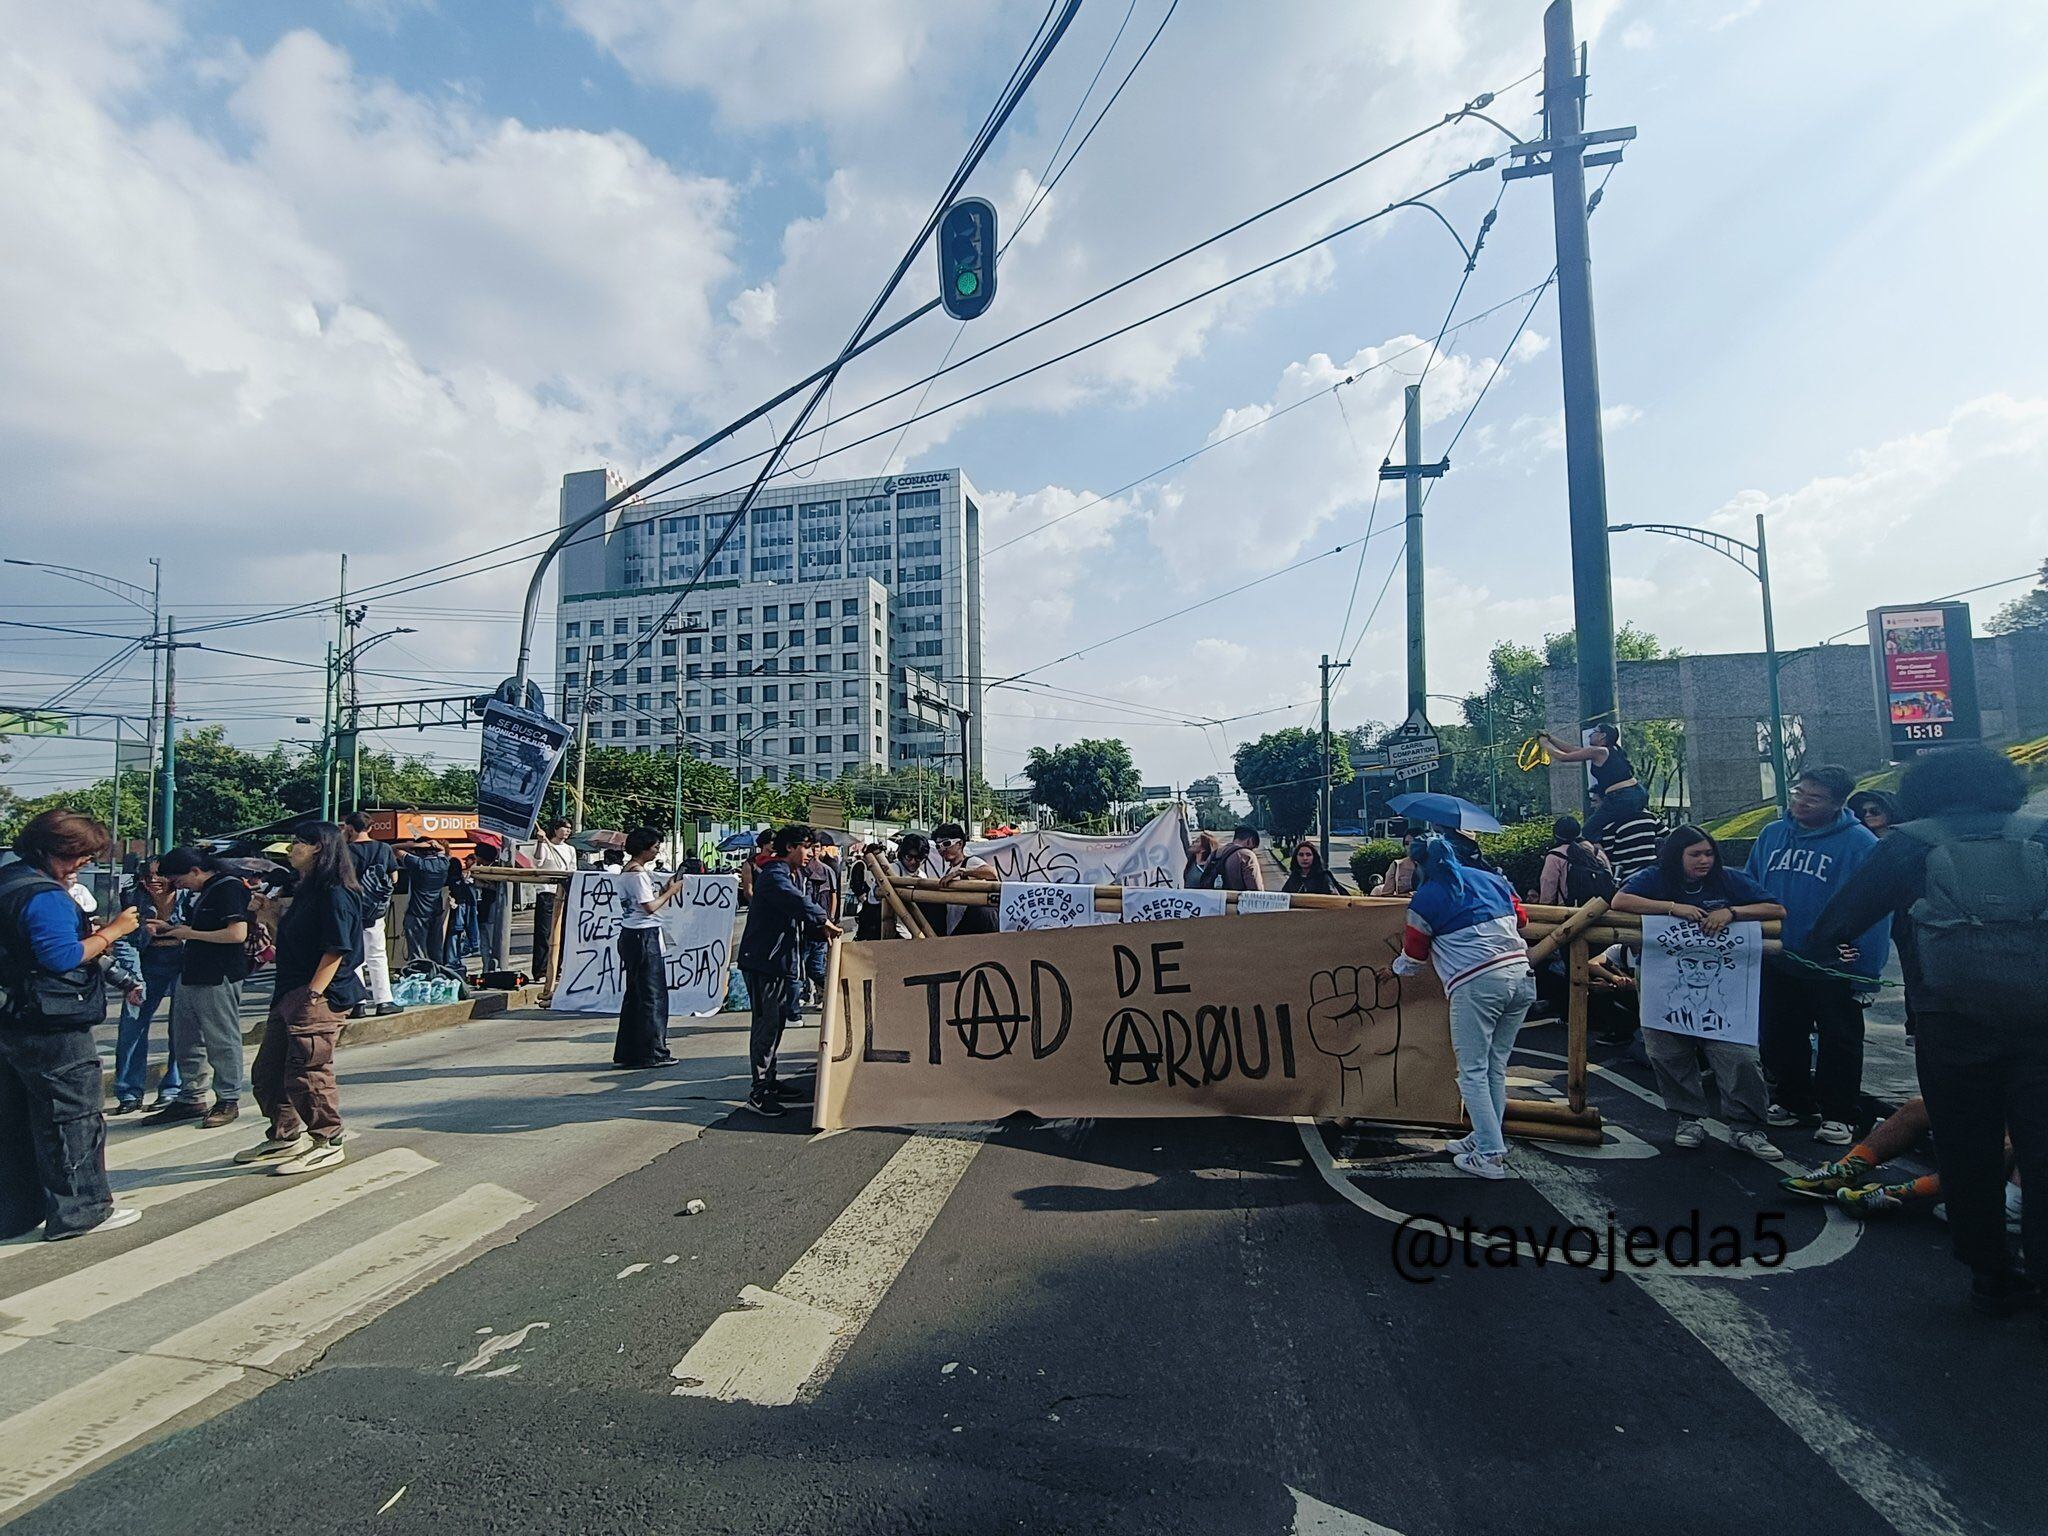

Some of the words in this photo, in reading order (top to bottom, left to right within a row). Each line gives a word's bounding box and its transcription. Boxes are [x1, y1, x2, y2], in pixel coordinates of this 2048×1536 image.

[897, 472, 951, 486] CONAGUA
[496, 718, 511, 729] SE
[511, 723, 549, 740] BUSCA
[1905, 725, 1943, 739] 15:18
[1392, 746, 1435, 759] COMPARTIDO
[1400, 742, 1424, 751] CARRIL
[1407, 761, 1437, 775] INICIA
[692, 878, 733, 909] LOS
[1005, 887, 1072, 915] DIRECTORA
[1113, 940, 1191, 999] DE
